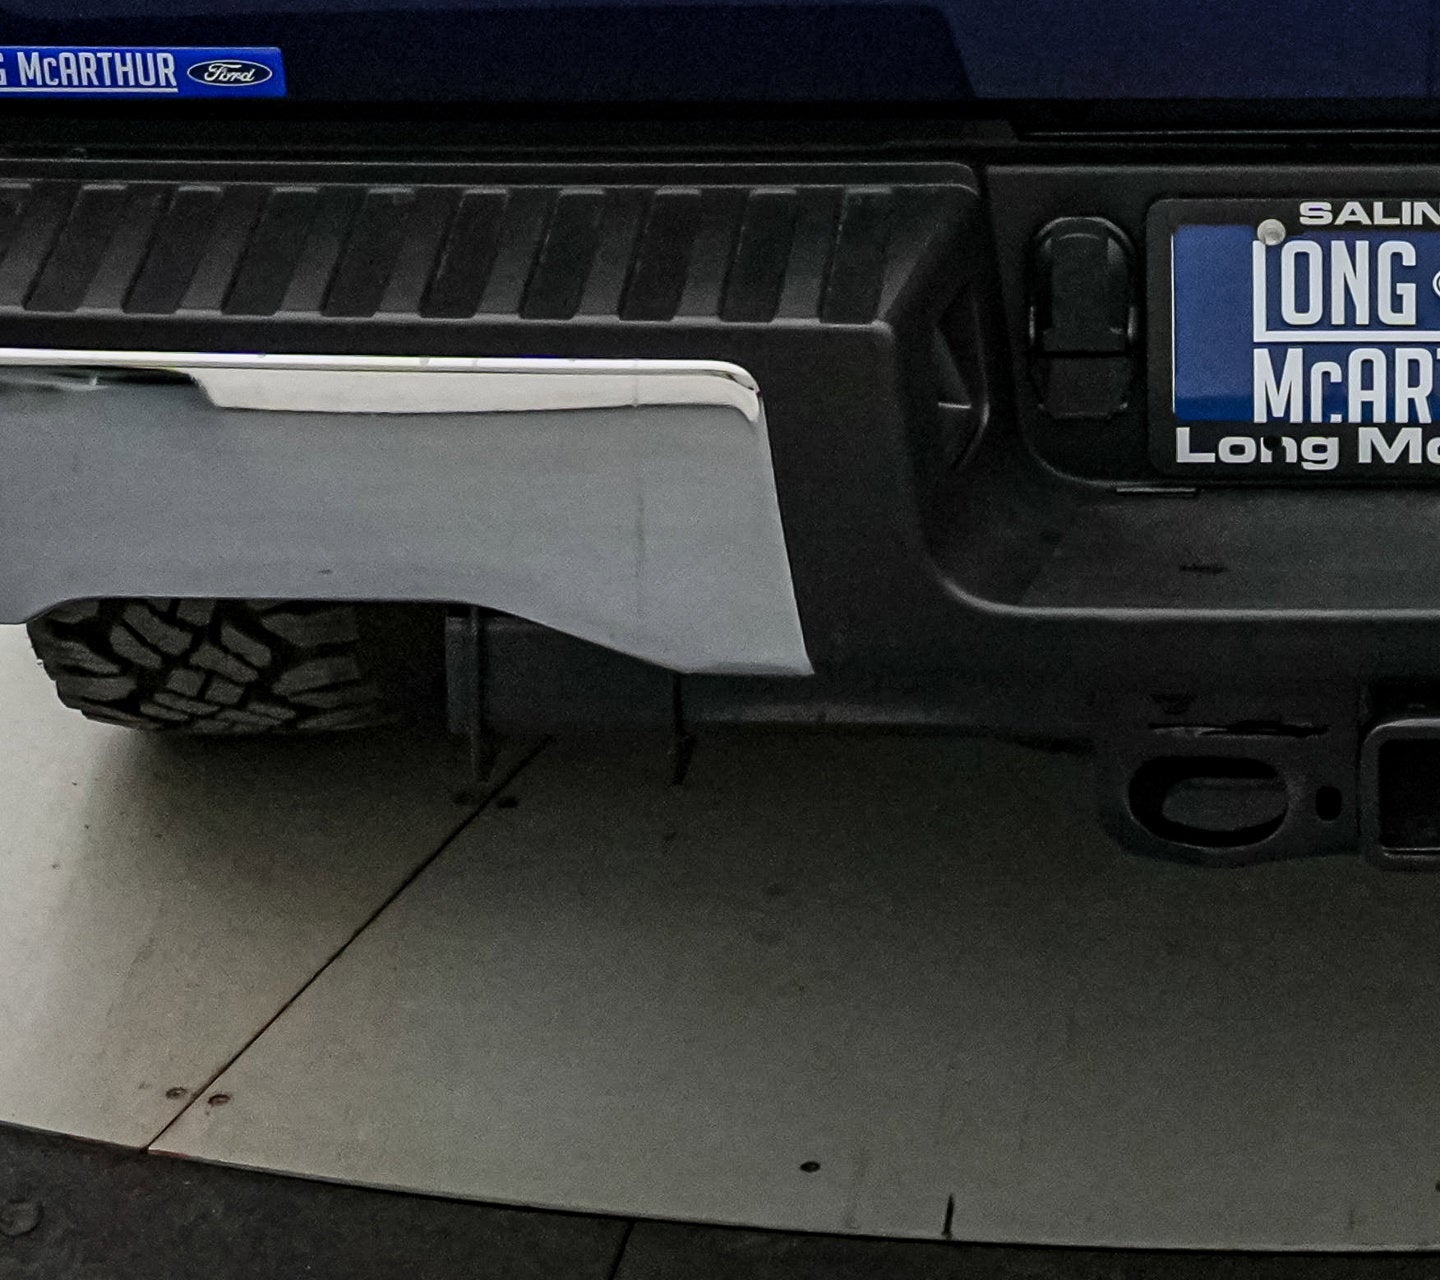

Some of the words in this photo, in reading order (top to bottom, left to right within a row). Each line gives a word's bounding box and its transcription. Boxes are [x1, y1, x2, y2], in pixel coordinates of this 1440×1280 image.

[17, 52, 177, 87] McARTHUR
[204, 63, 255, 82] Ford
[1252, 240, 1417, 342] LONG
